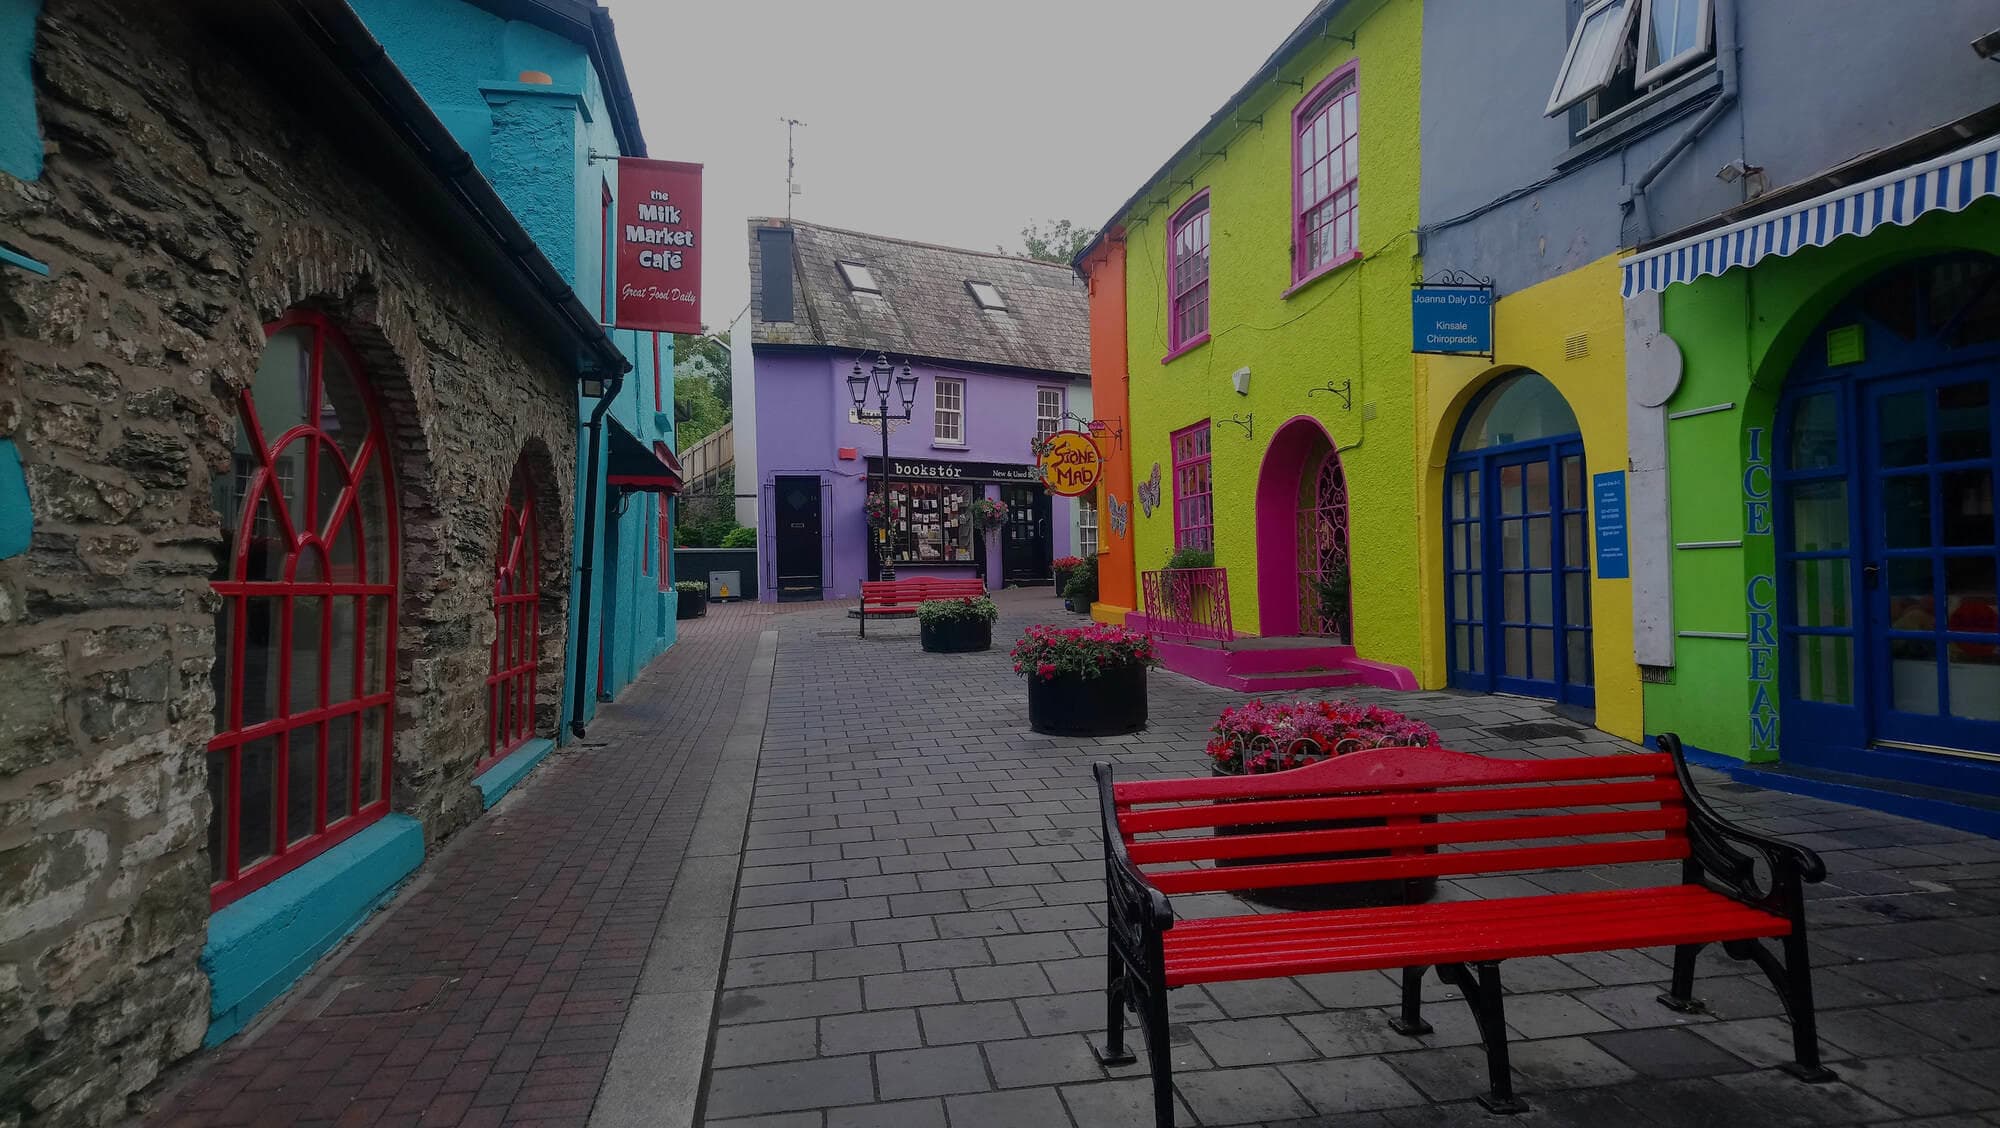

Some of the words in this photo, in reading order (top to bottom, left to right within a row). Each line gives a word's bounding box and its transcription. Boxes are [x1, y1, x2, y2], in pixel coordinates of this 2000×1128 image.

[650, 190, 669, 201] the
[638, 203, 681, 225] Milk
[626, 225, 694, 247] Market
[639, 250, 683, 272] Café
[622, 283, 646, 300] Great
[648, 287, 669, 301] Food
[671, 288, 697, 306] Daily
[1414, 294, 1446, 304] Joanna
[1448, 294, 1467, 306] Daly
[1470, 295, 1489, 304] D.C.
[1436, 321, 1468, 330] Kinsale
[1426, 334, 1478, 345] Chiropractic
[894, 462, 962, 478] bookstór
[1056, 466, 1093, 486] MAD
[1743, 427, 1772, 536] ICE
[1747, 575, 1779, 751] CREAM
